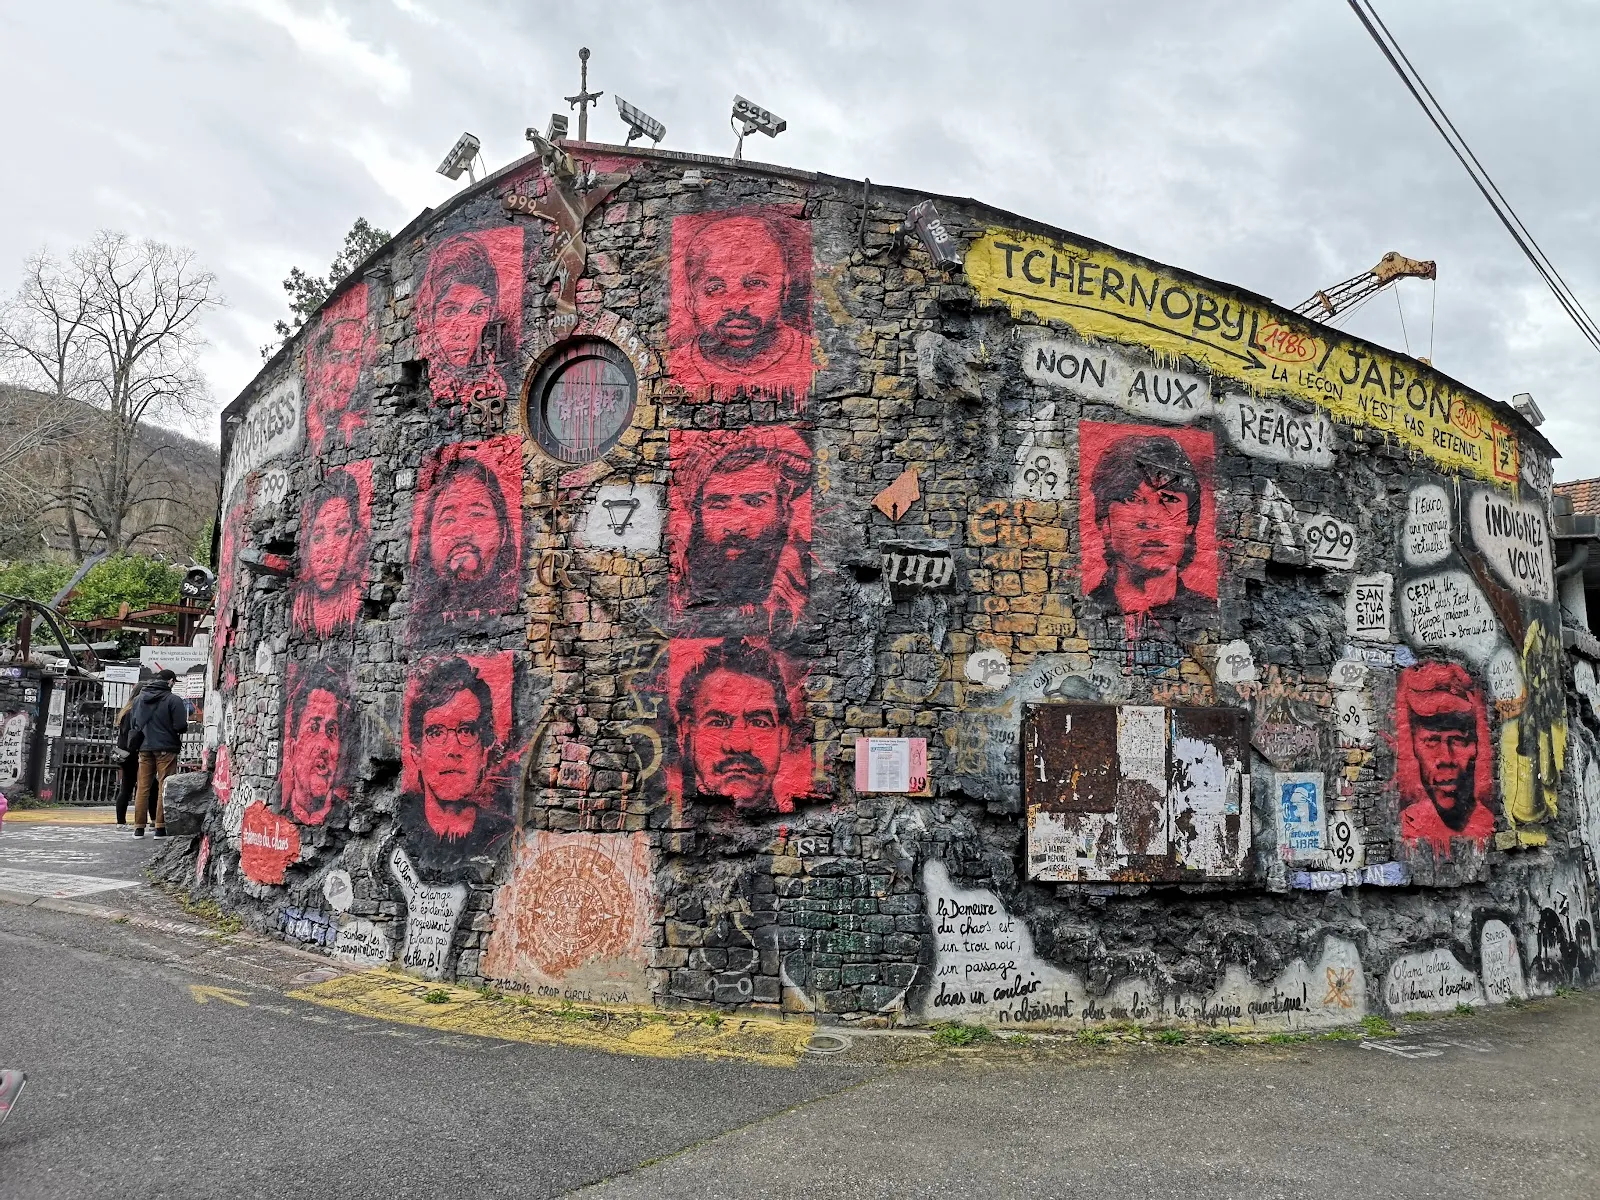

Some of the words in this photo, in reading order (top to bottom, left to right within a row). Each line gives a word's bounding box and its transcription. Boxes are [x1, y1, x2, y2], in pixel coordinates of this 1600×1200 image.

[737, 100, 772, 125] 999
[507, 195, 537, 213] 999
[394, 282, 411, 298] 999
[994, 242, 1266, 350] TCHERNOBYL
[1264, 328, 1308, 358] 1986
[1340, 350, 1451, 424] JAPON
[1036, 348, 1107, 388] NON
[1128, 371, 1198, 408] AUX
[1271, 364, 1288, 383] LA
[1298, 369, 1343, 401] LEÇON
[1359, 397, 1396, 422] N'EST
[1404, 414, 1425, 437] PAS
[1432, 429, 1483, 463] RETENUE!
[1500, 451, 1508, 471] 7
[1306, 519, 1354, 555] 999
[1508, 547, 1546, 586] VOUS!
[1355, 588, 1384, 602] SAN
[1355, 602, 1384, 613] CTUA
[1288, 838, 1320, 849] LIBRE
[936, 898, 949, 918] la
[949, 899, 998, 919] Demeure
[937, 916, 955, 934] du
[960, 919, 992, 936] chaos
[998, 916, 1015, 933] est
[939, 942, 959, 953] un
[963, 940, 990, 953] trou
[938, 964, 959, 977] un
[965, 960, 1018, 980] passage
[1393, 959, 1423, 980] Obama
[537, 985, 560, 998] CROP
[564, 987, 593, 1001] CIRCLE
[600, 990, 629, 1003] MAYA
[934, 981, 967, 1008] dans
[969, 990, 989, 1005] un
[993, 971, 1042, 1001] couloir
[1247, 982, 1311, 1026] quantique!
